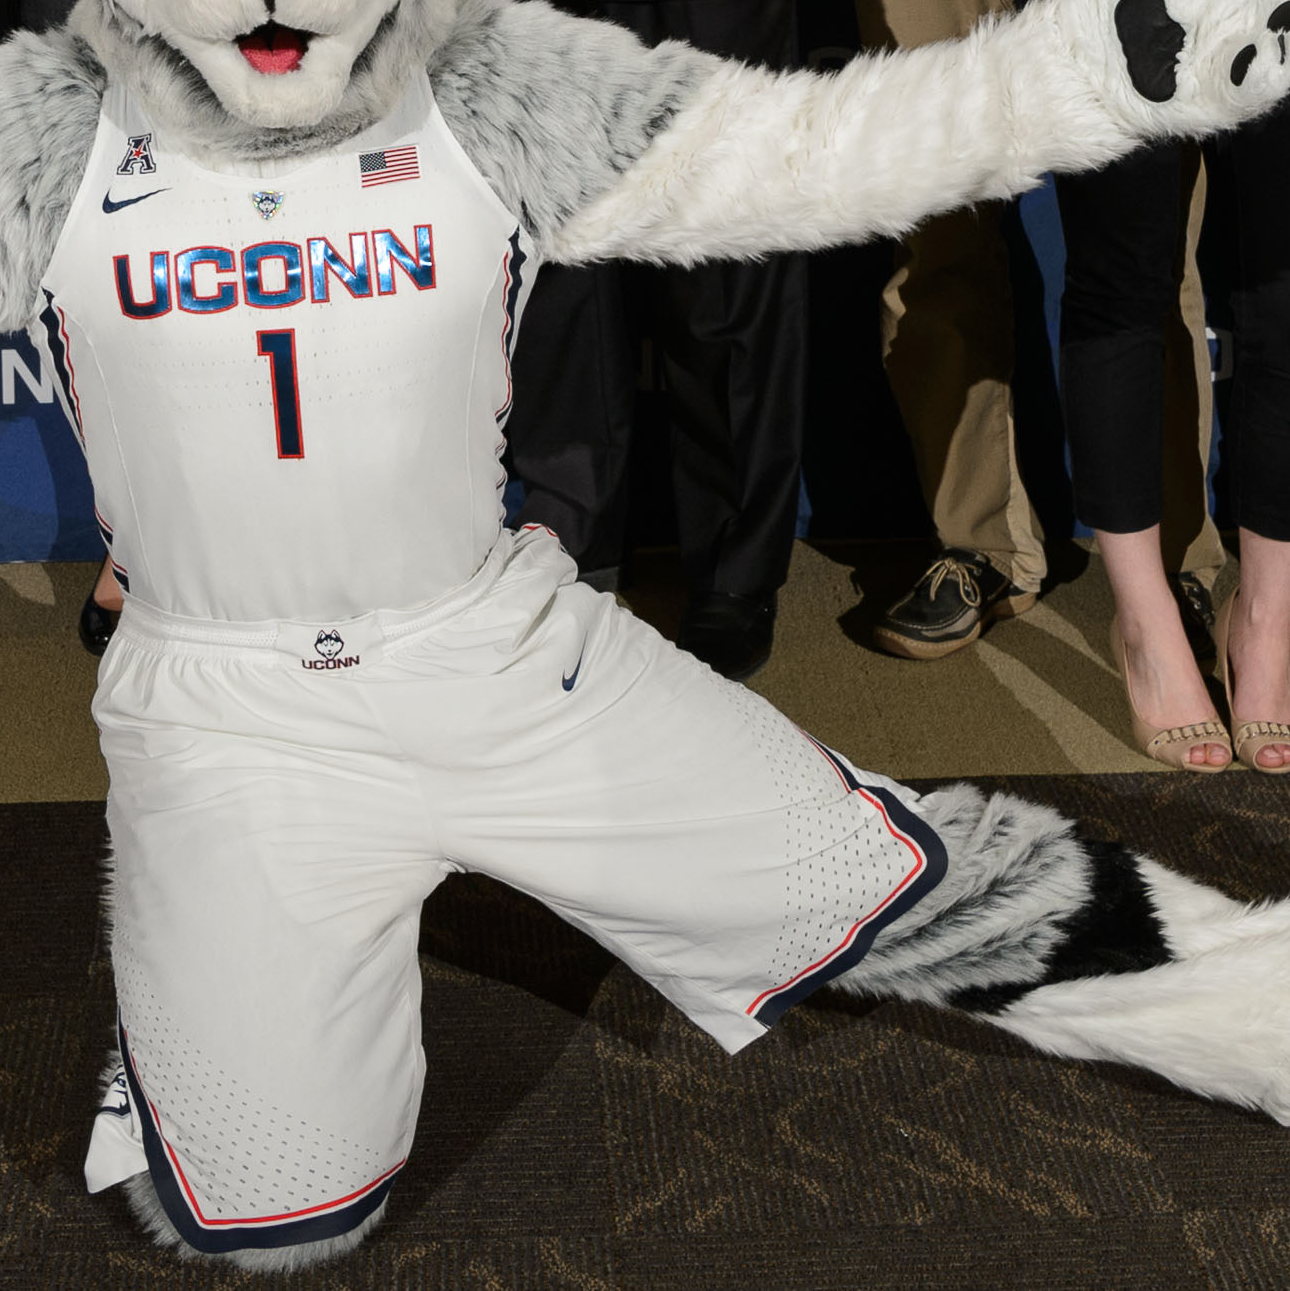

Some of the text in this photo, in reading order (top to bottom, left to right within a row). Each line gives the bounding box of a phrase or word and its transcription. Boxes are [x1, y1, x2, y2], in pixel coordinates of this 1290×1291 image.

[113, 224, 436, 319] UCONN
[256, 328, 304, 459] 1
[302, 655, 360, 670] UCONN
